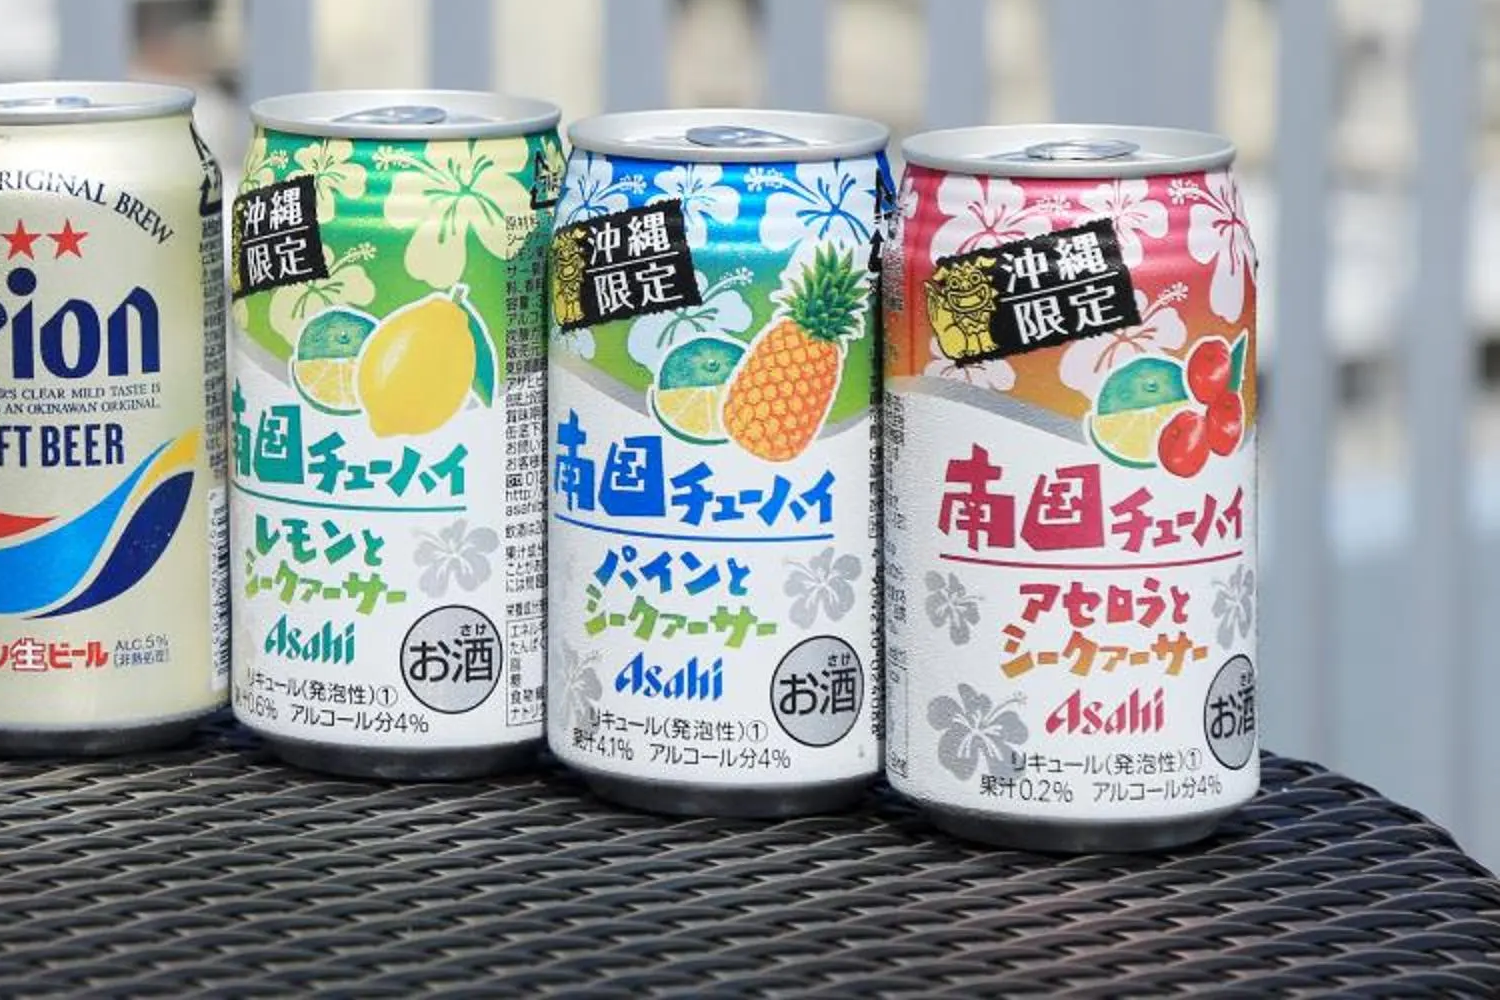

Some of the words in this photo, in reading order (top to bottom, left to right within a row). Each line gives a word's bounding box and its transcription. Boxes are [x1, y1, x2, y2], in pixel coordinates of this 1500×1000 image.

[114, 190, 175, 246] BREW
[244, 187, 303, 238] 沖縄
[247, 239, 313, 285] 限定
[588, 211, 671, 266] 沖縄
[1001, 231, 1109, 294] 沖縄
[594, 265, 684, 318] 限定
[1013, 285, 1125, 345] 限定
[5, 402, 23, 414] AN
[27, 402, 98, 415] OKINAWAN
[21, 387, 66, 400] CLEAR
[71, 387, 105, 400] MILD
[109, 383, 147, 397] TASTE
[150, 381, 161, 393] IS
[41, 423, 126, 467] BEER
[231, 377, 469, 498] 南国チューハイ
[554, 407, 836, 527] 南国チューハイ
[937, 442, 1245, 554] 南国チューハイ
[254, 513, 385, 567] レモンと
[592, 544, 751, 597] パインと
[1019, 576, 1192, 629] アセロラと
[264, 612, 356, 666] Asahi
[460, 623, 487, 637] さけ
[408, 637, 495, 684] お酒
[614, 651, 724, 702] Asahi
[827, 654, 852, 668] さけ
[779, 667, 858, 717] お酒
[1045, 687, 1166, 736] Asahi
[290, 702, 430, 734] アルコール分4%
[649, 742, 792, 769] アルコール分4%
[979, 775, 1074, 804] 果汁0.2%
[1092, 773, 1224, 803] アルコール分4%
